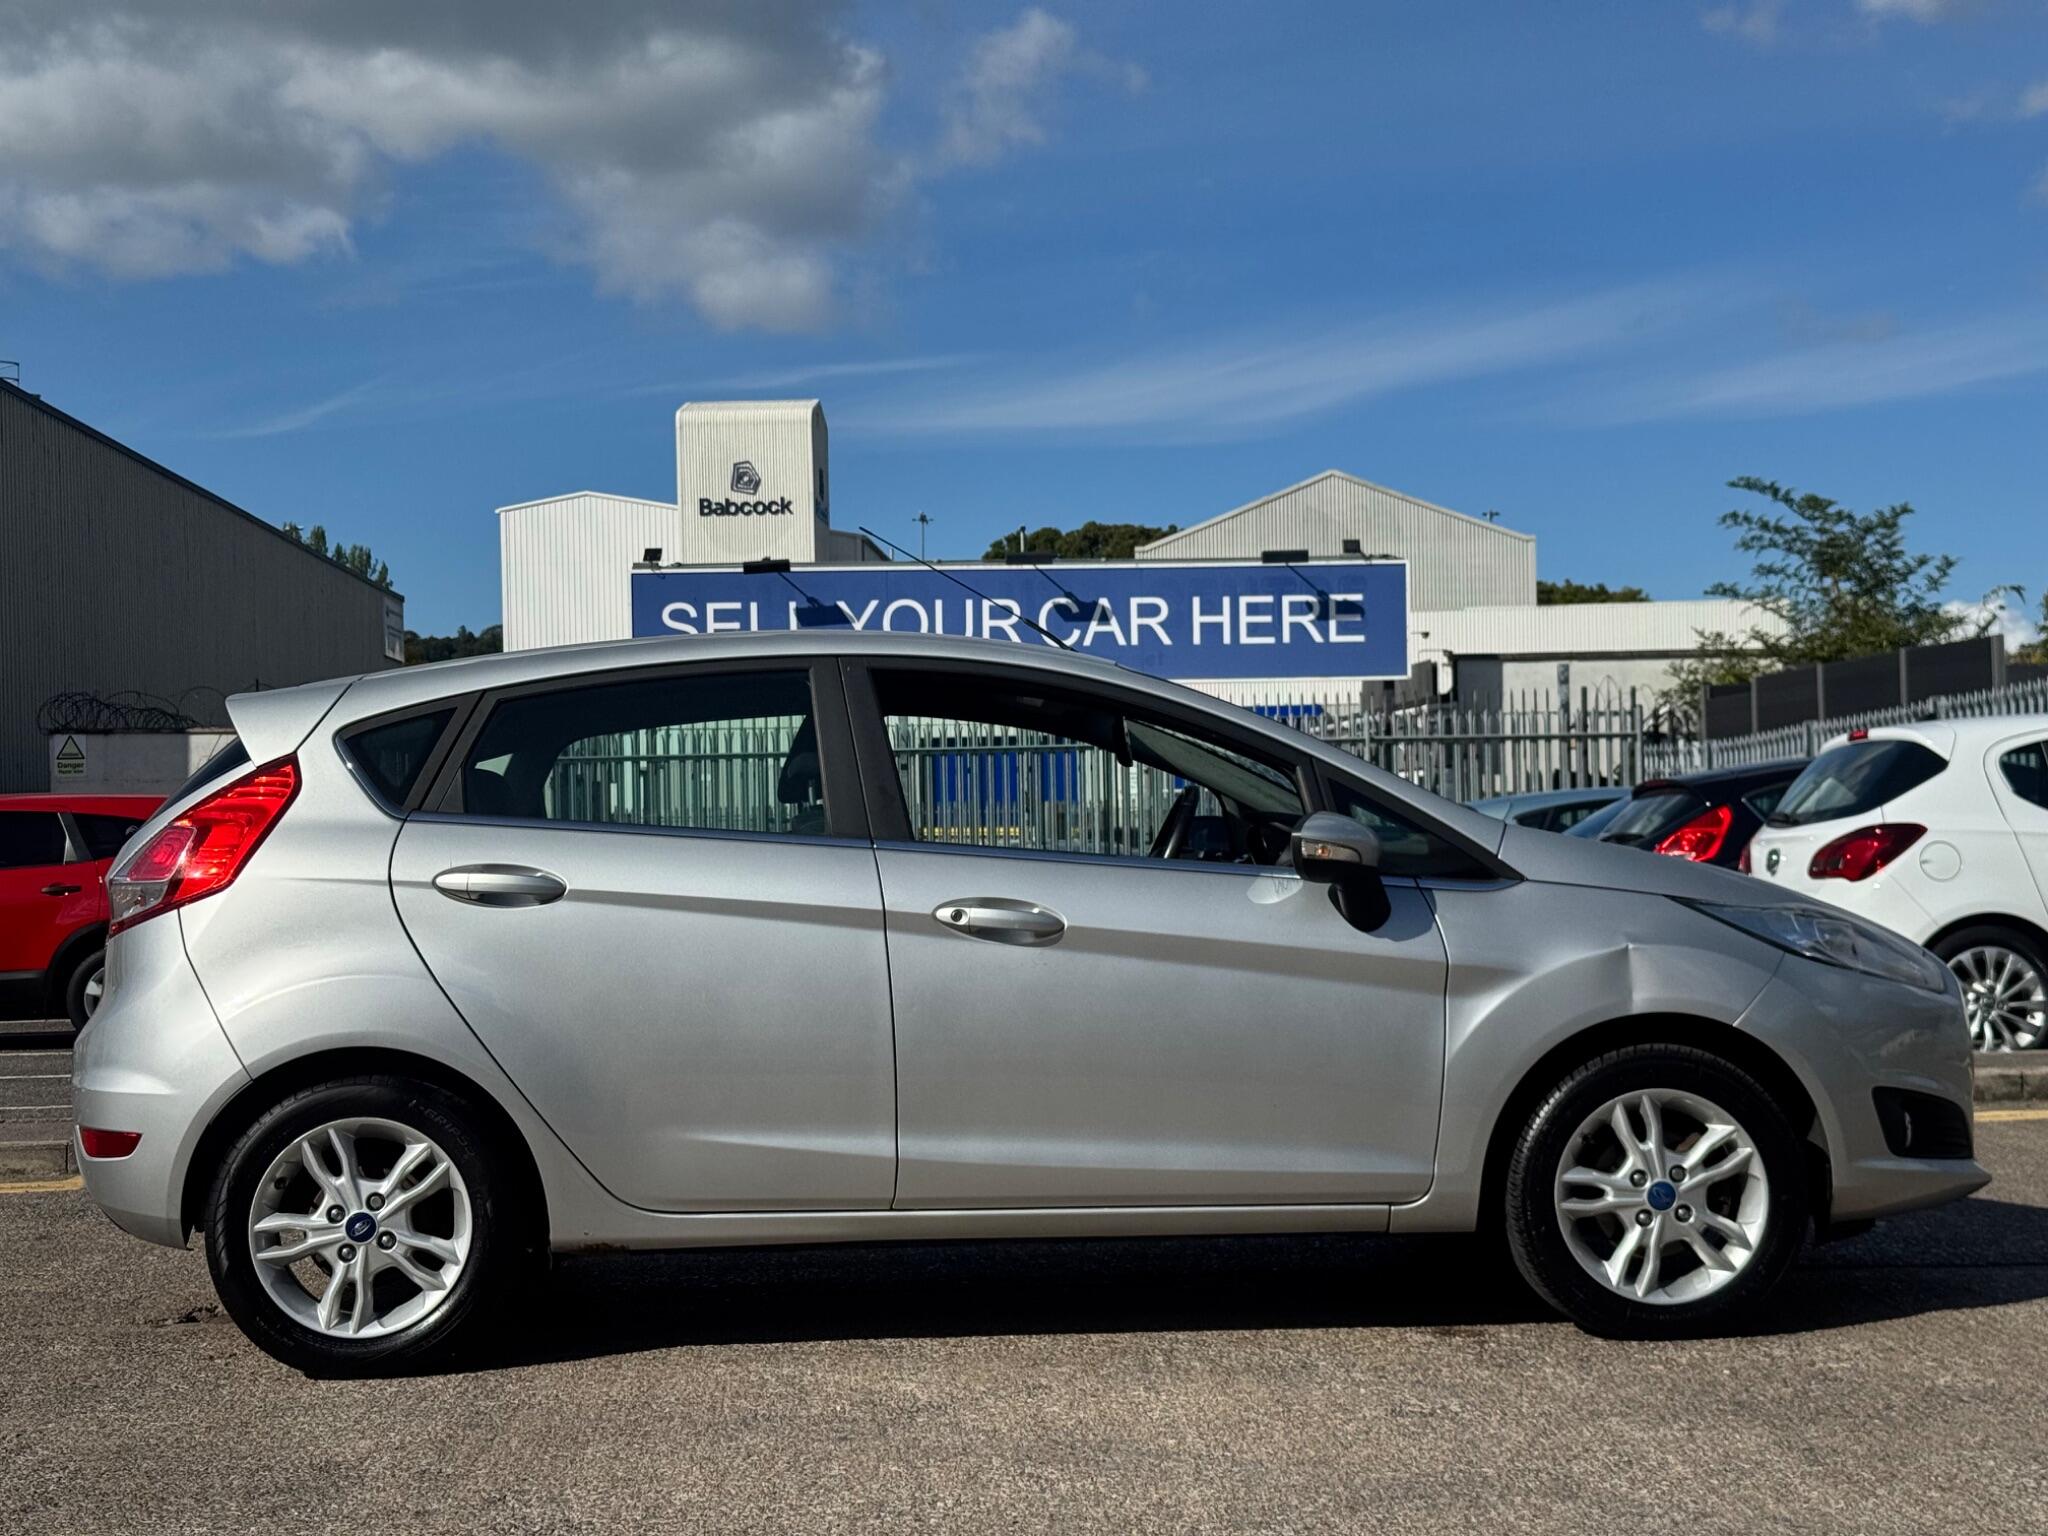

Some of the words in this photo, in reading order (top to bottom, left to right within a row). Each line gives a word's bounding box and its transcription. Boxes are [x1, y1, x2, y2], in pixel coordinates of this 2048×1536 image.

[699, 497, 793, 516] Babcock
[836, 598, 1021, 642] YOUR
[1038, 595, 1172, 646] CAR
[1192, 593, 1365, 645] HERE
